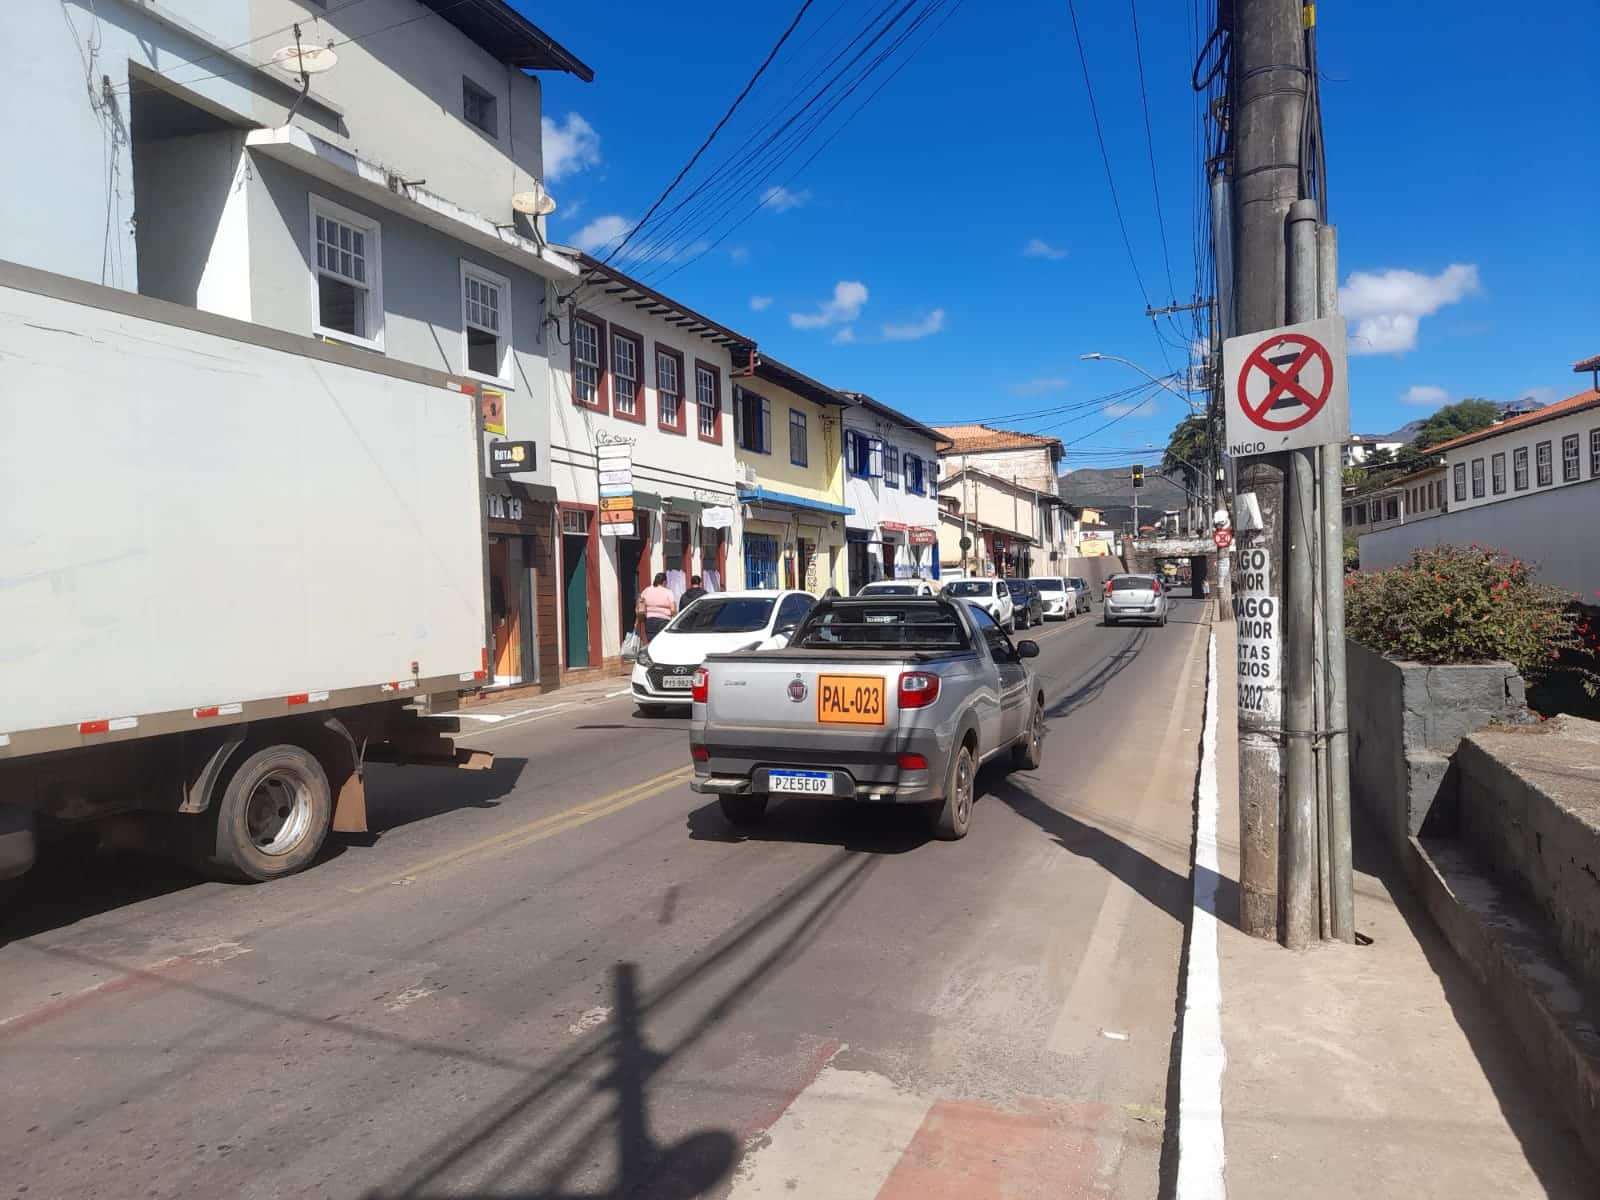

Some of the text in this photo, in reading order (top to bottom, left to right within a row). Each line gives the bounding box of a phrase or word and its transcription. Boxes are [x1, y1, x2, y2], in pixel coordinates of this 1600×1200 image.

[1230, 441, 1266, 456] INÍCIO
[823, 685, 880, 715] PAL-023
[775, 777, 827, 792] PZE5E09
